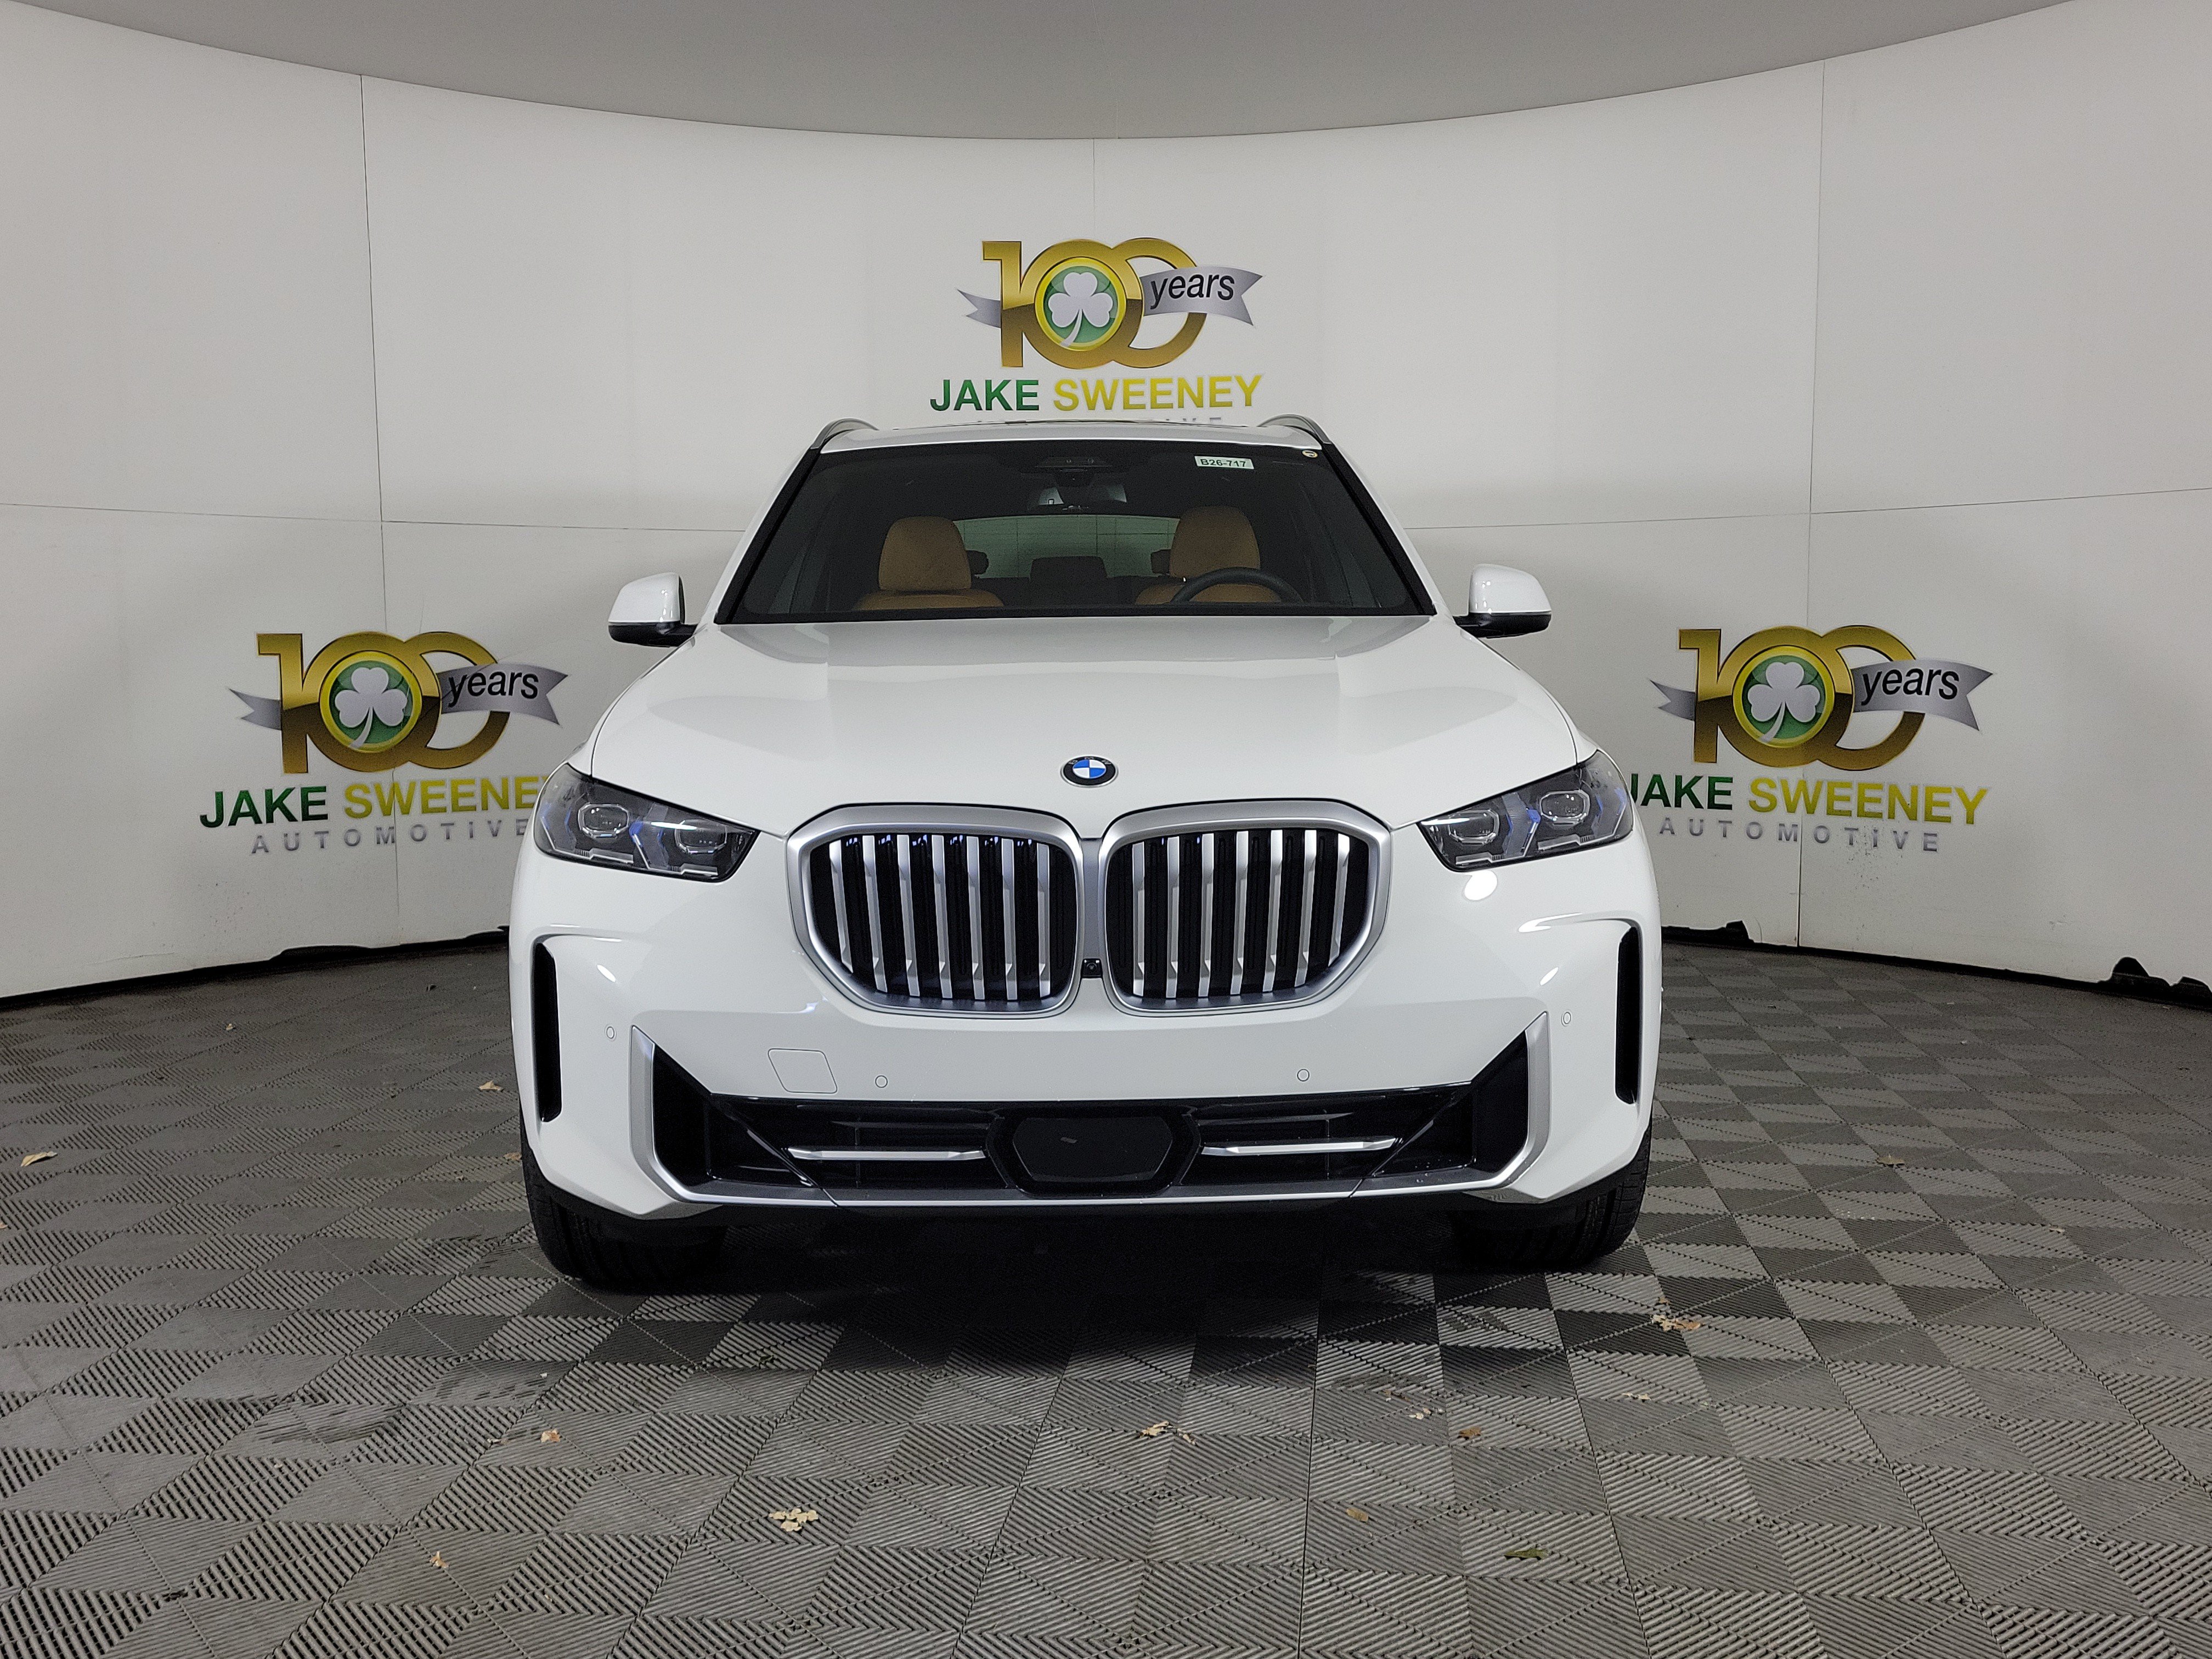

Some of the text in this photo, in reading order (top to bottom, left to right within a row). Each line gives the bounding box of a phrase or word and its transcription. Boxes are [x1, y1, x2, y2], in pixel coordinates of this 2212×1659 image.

[981, 237, 1235, 369] 100 years
[929, 374, 1262, 411] JAKE SWEENEY
[1200, 459, 1246, 467] B26-717
[256, 631, 539, 774] 100 years
[1678, 625, 1959, 771] 100 years
[199, 775, 549, 827] JAKE SWEENE
[1748, 777, 1989, 825] SWEENEY
[251, 819, 528, 854] AUTOMOTIVE
[1659, 816, 1938, 852] AUTOMOTIVE
